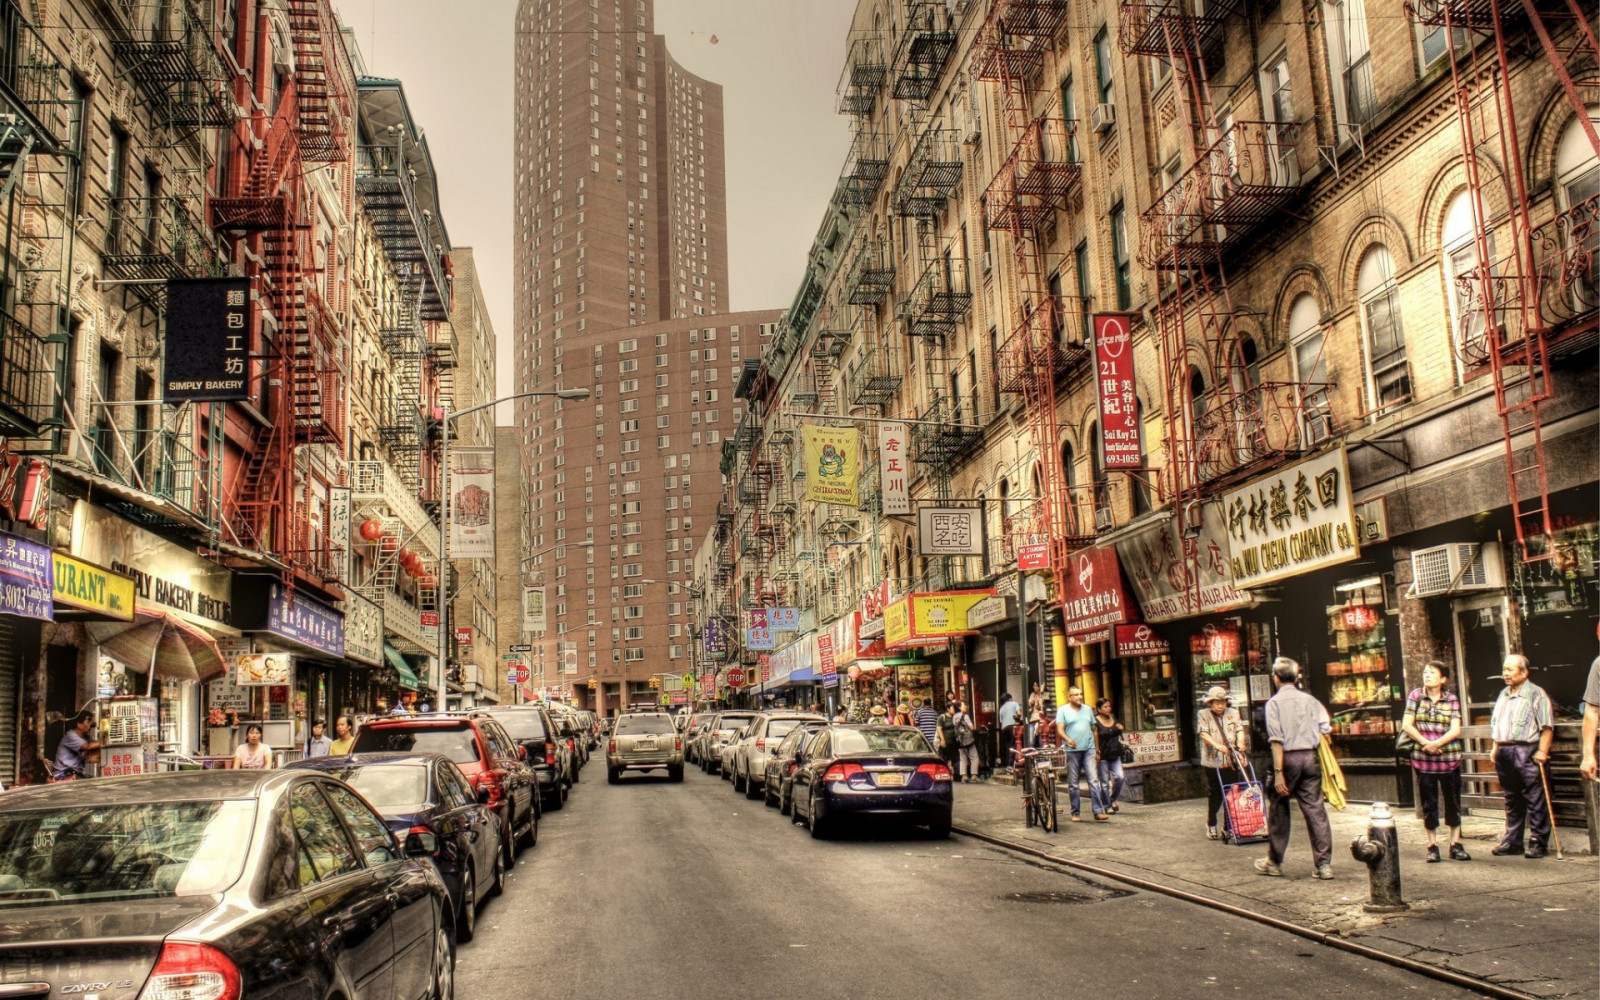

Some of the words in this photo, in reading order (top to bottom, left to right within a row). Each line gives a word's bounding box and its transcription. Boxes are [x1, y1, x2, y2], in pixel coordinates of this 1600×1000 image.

[224, 290, 245, 374] 麵包工坊
[169, 382, 202, 391] SIMPLY
[205, 380, 244, 390] BAKERY
[1121, 379, 1135, 427] 美容中心
[1129, 429, 1138, 439] 21
[1106, 454, 1140, 463] 693-1055
[933, 514, 969, 531] 西安
[934, 530, 969, 546] 名吃
[1290, 522, 1334, 564] COMPANY
[1022, 552, 1044, 560] ANYTIME
[155, 576, 194, 614] BAKERY
[1065, 589, 1120, 620] 21世紀美容中心
[1143, 599, 1178, 619] BAYARD
[516, 671, 530, 679] TOP
[727, 674, 744, 682] STOP
[1156, 731, 1176, 744] 飯店
[1140, 745, 1177, 753] RESTAURANT
[61, 981, 112, 994] CAMRY
[116, 979, 132, 989] LE
